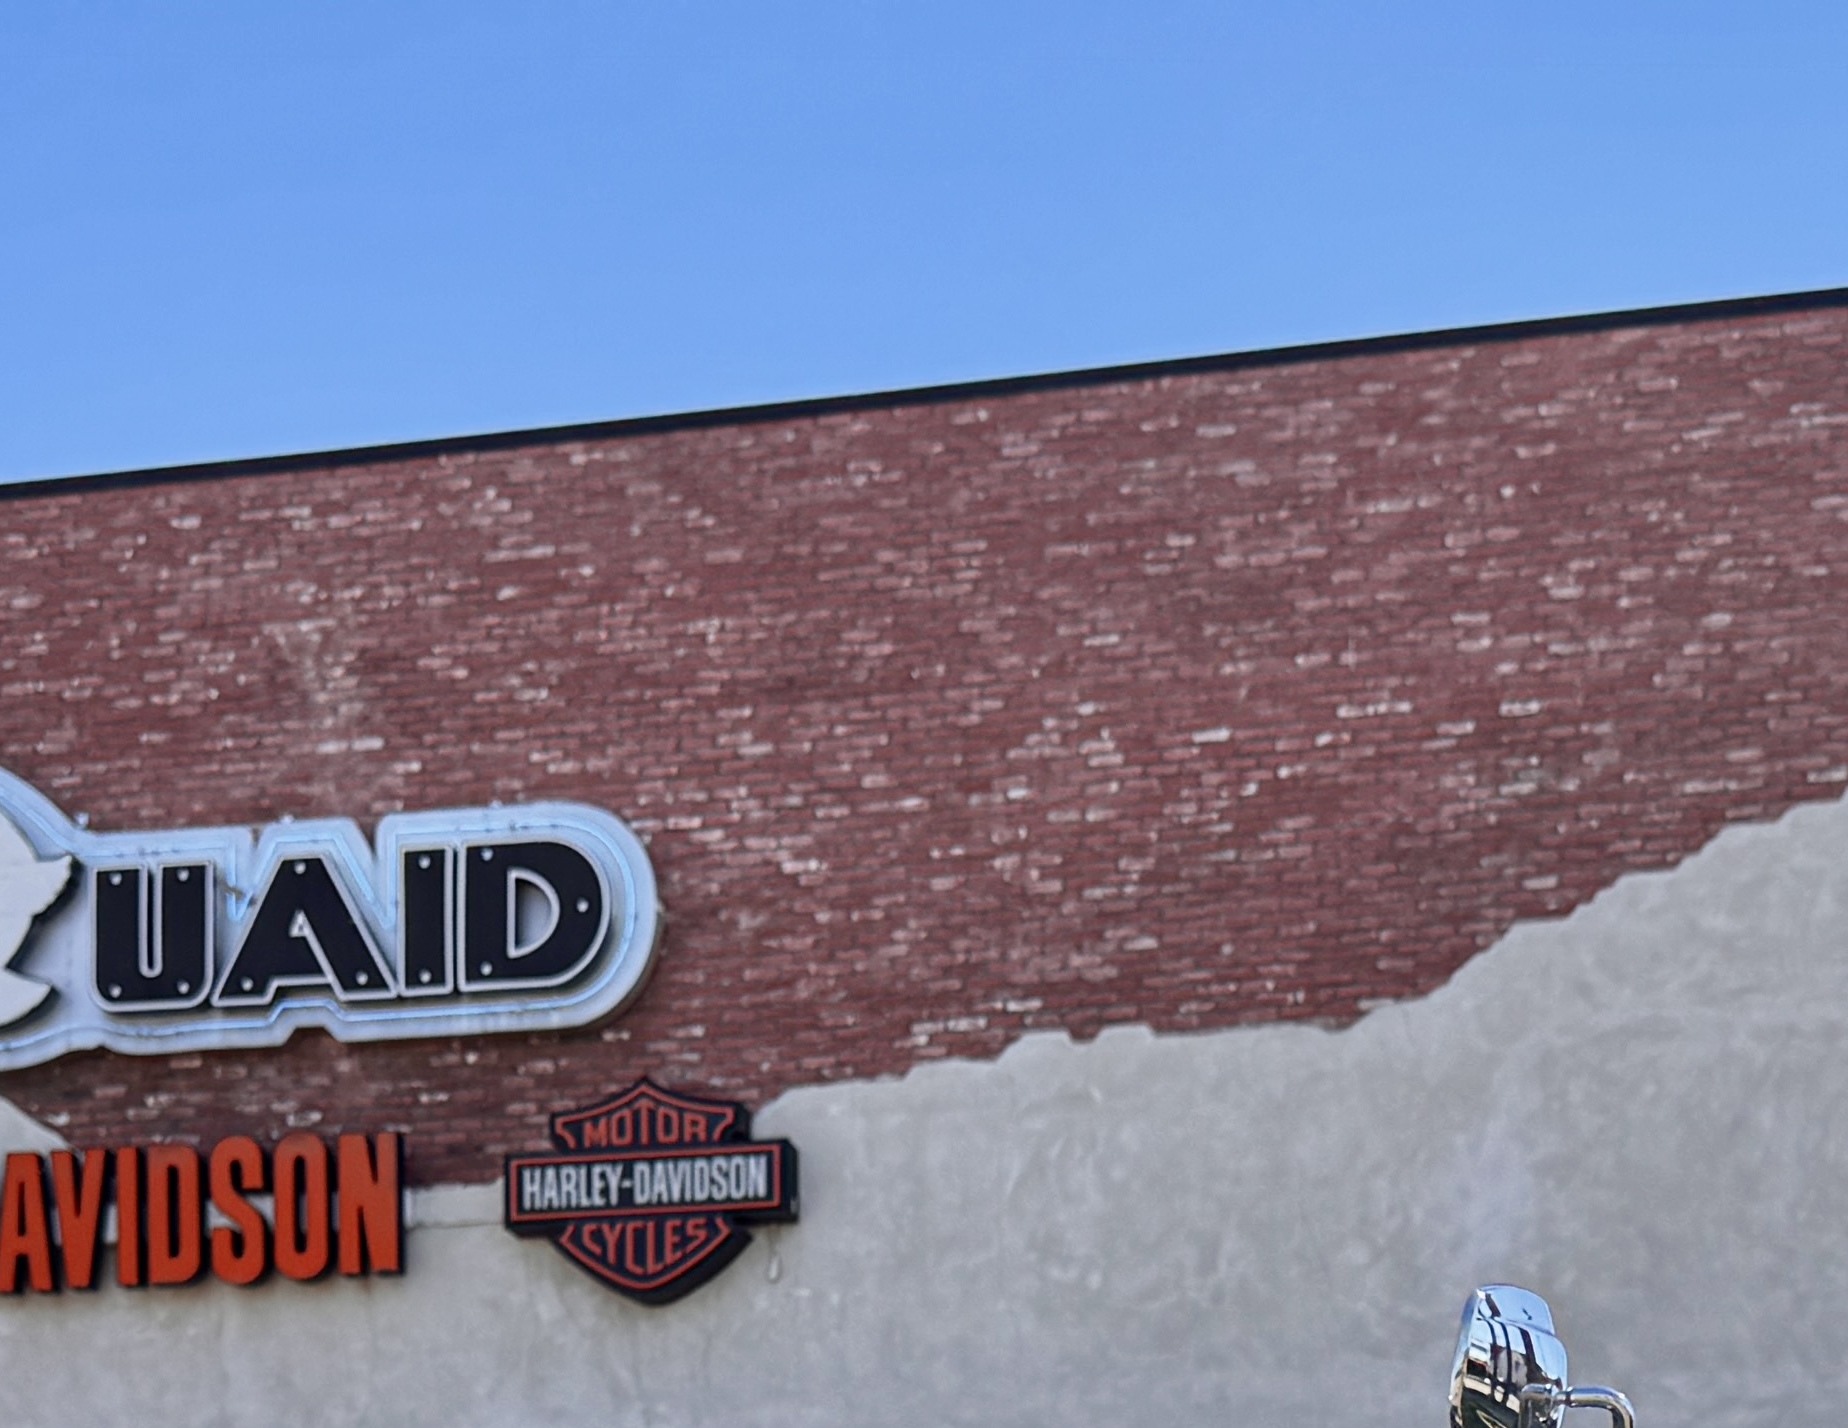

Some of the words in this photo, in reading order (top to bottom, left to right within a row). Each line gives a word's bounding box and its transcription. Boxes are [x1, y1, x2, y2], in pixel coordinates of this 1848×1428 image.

[583, 1098, 709, 1148] MOTOR
[521, 1153, 769, 1211] HARLEY-DAVIDSON
[581, 1217, 709, 1276] CYCLES
